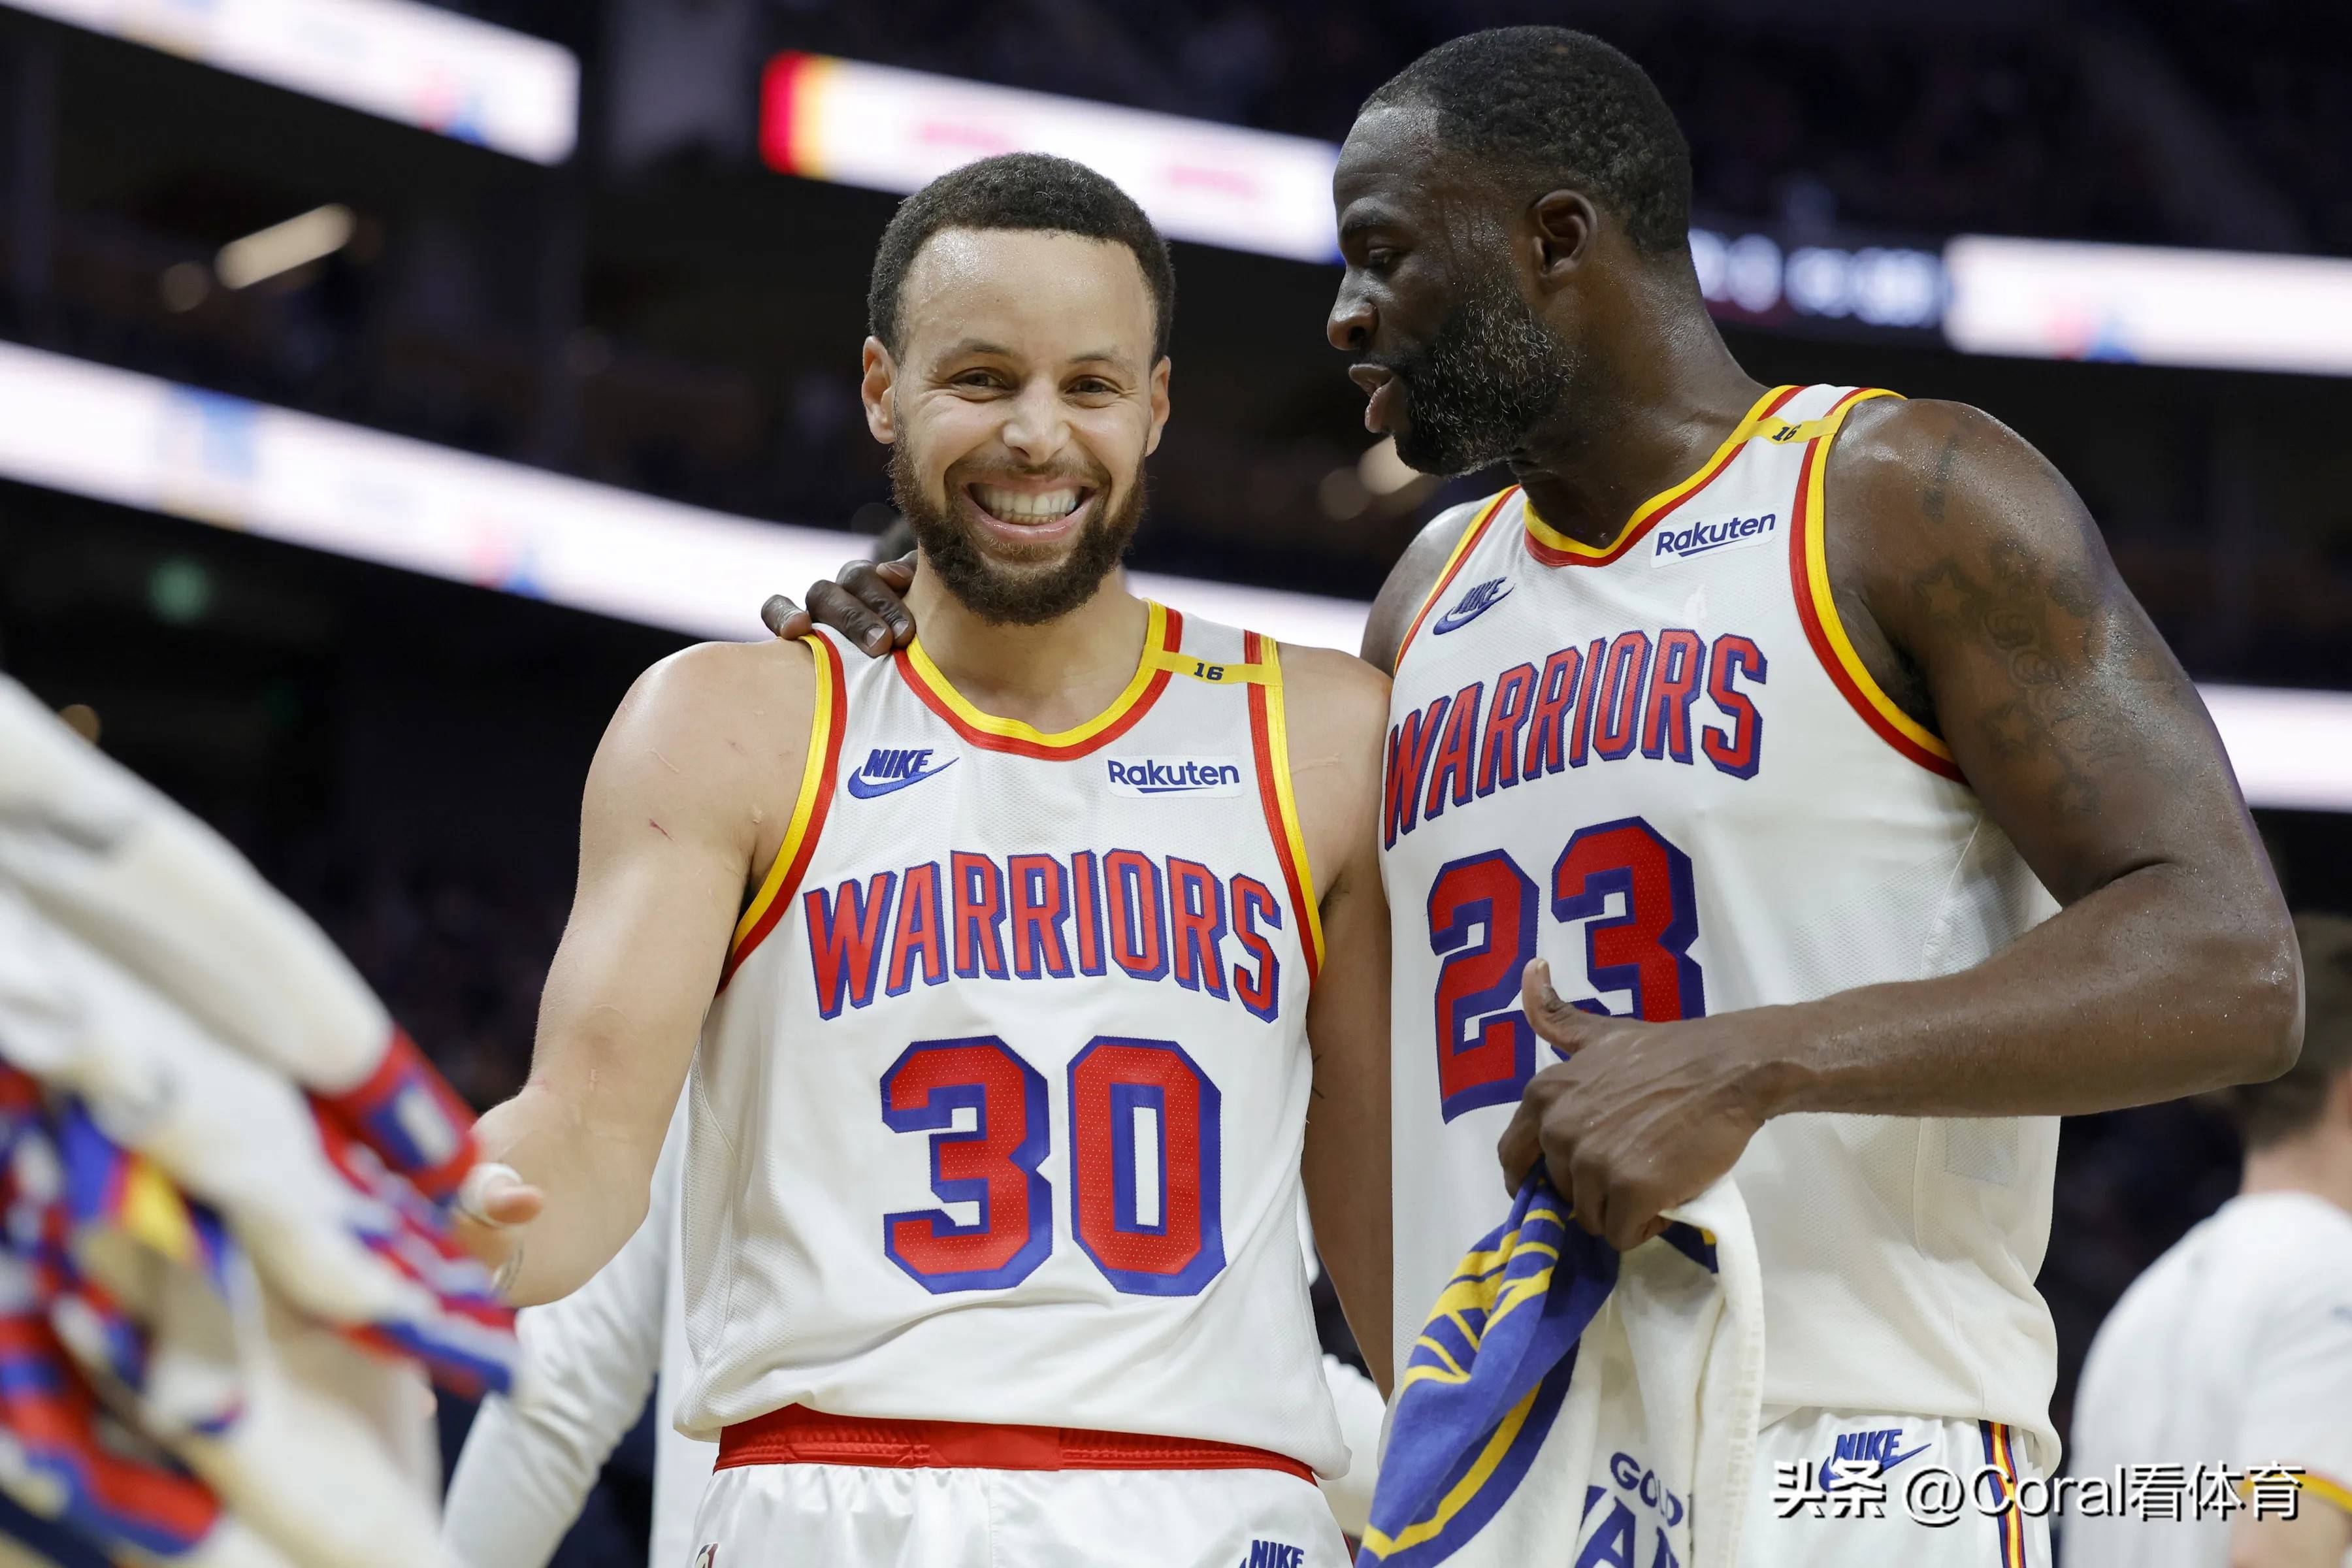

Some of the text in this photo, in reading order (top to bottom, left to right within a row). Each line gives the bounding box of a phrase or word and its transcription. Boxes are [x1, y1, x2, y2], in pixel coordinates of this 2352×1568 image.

[1771, 423, 1802, 442] 16
[1656, 514, 1776, 556] Rakuten
[1450, 576, 1507, 615] NIKE
[1193, 662, 1224, 681] 16
[1384, 629, 1768, 851] WARRIORS
[862, 749, 934, 779] NIKE
[1108, 759, 1240, 788] Rakuten
[803, 848, 1282, 1024] WARRIORS
[1427, 815, 1707, 1125] 23
[879, 1035, 1227, 1297] 30
[1831, 1429, 1903, 1462] NIKE
[1249, 1539, 1304, 1568] NIKE
